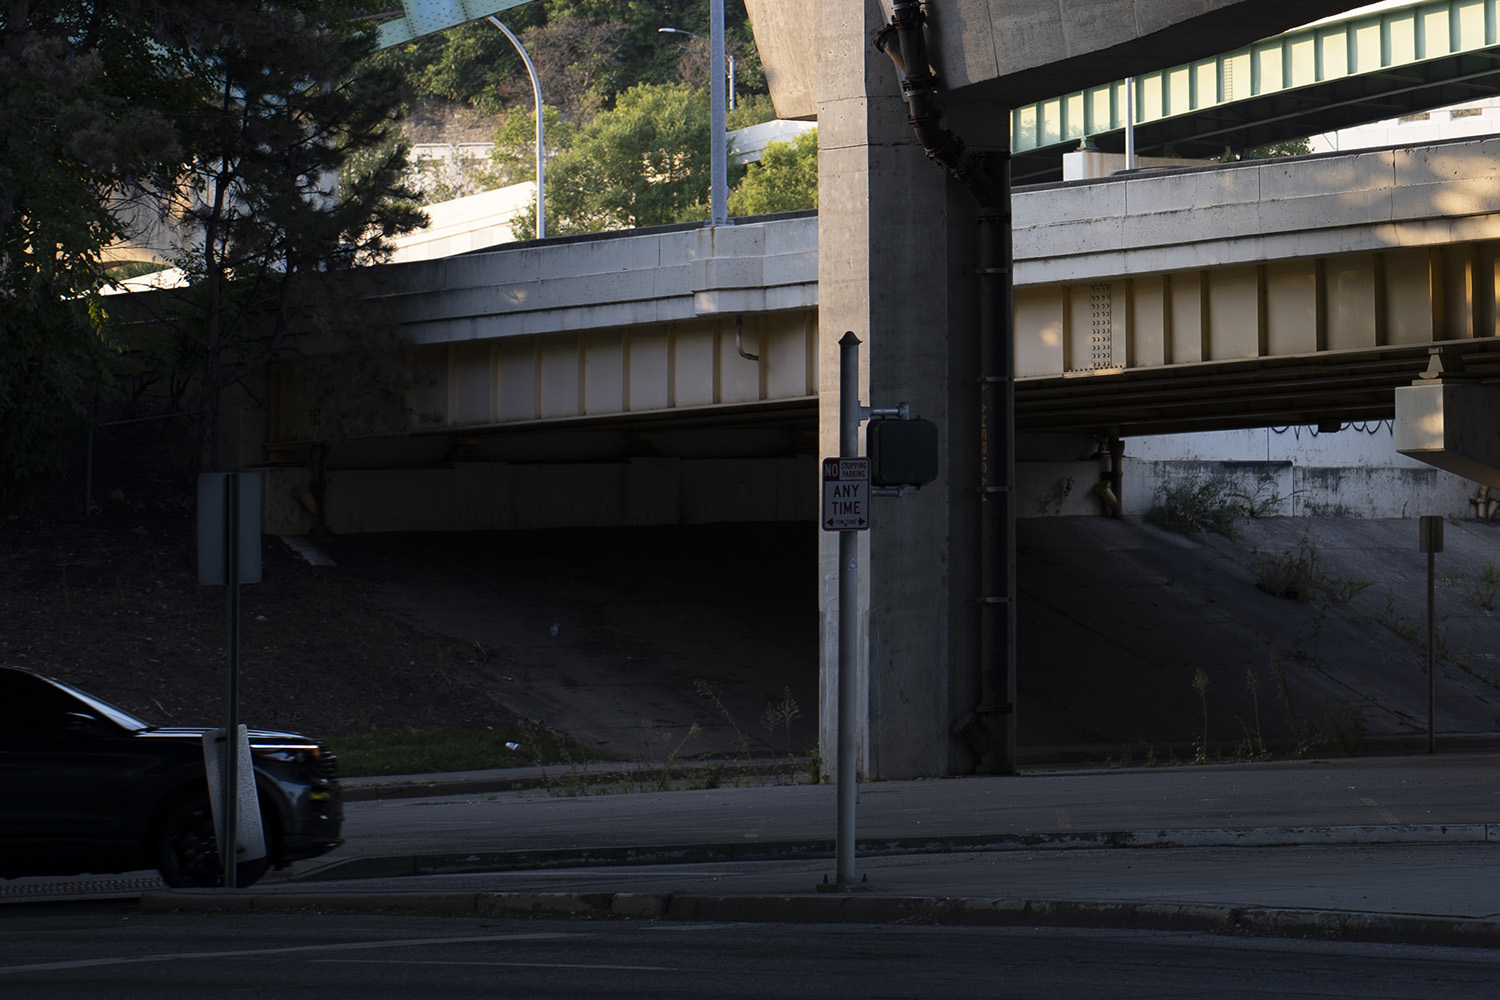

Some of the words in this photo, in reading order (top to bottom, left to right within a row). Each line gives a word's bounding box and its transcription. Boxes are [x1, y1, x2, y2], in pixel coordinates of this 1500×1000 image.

[824, 463, 839, 477] NO
[841, 462, 867, 470] STOPPING
[842, 470, 866, 478] PARKING
[833, 485, 859, 498] ANY
[832, 502, 861, 514] TIME
